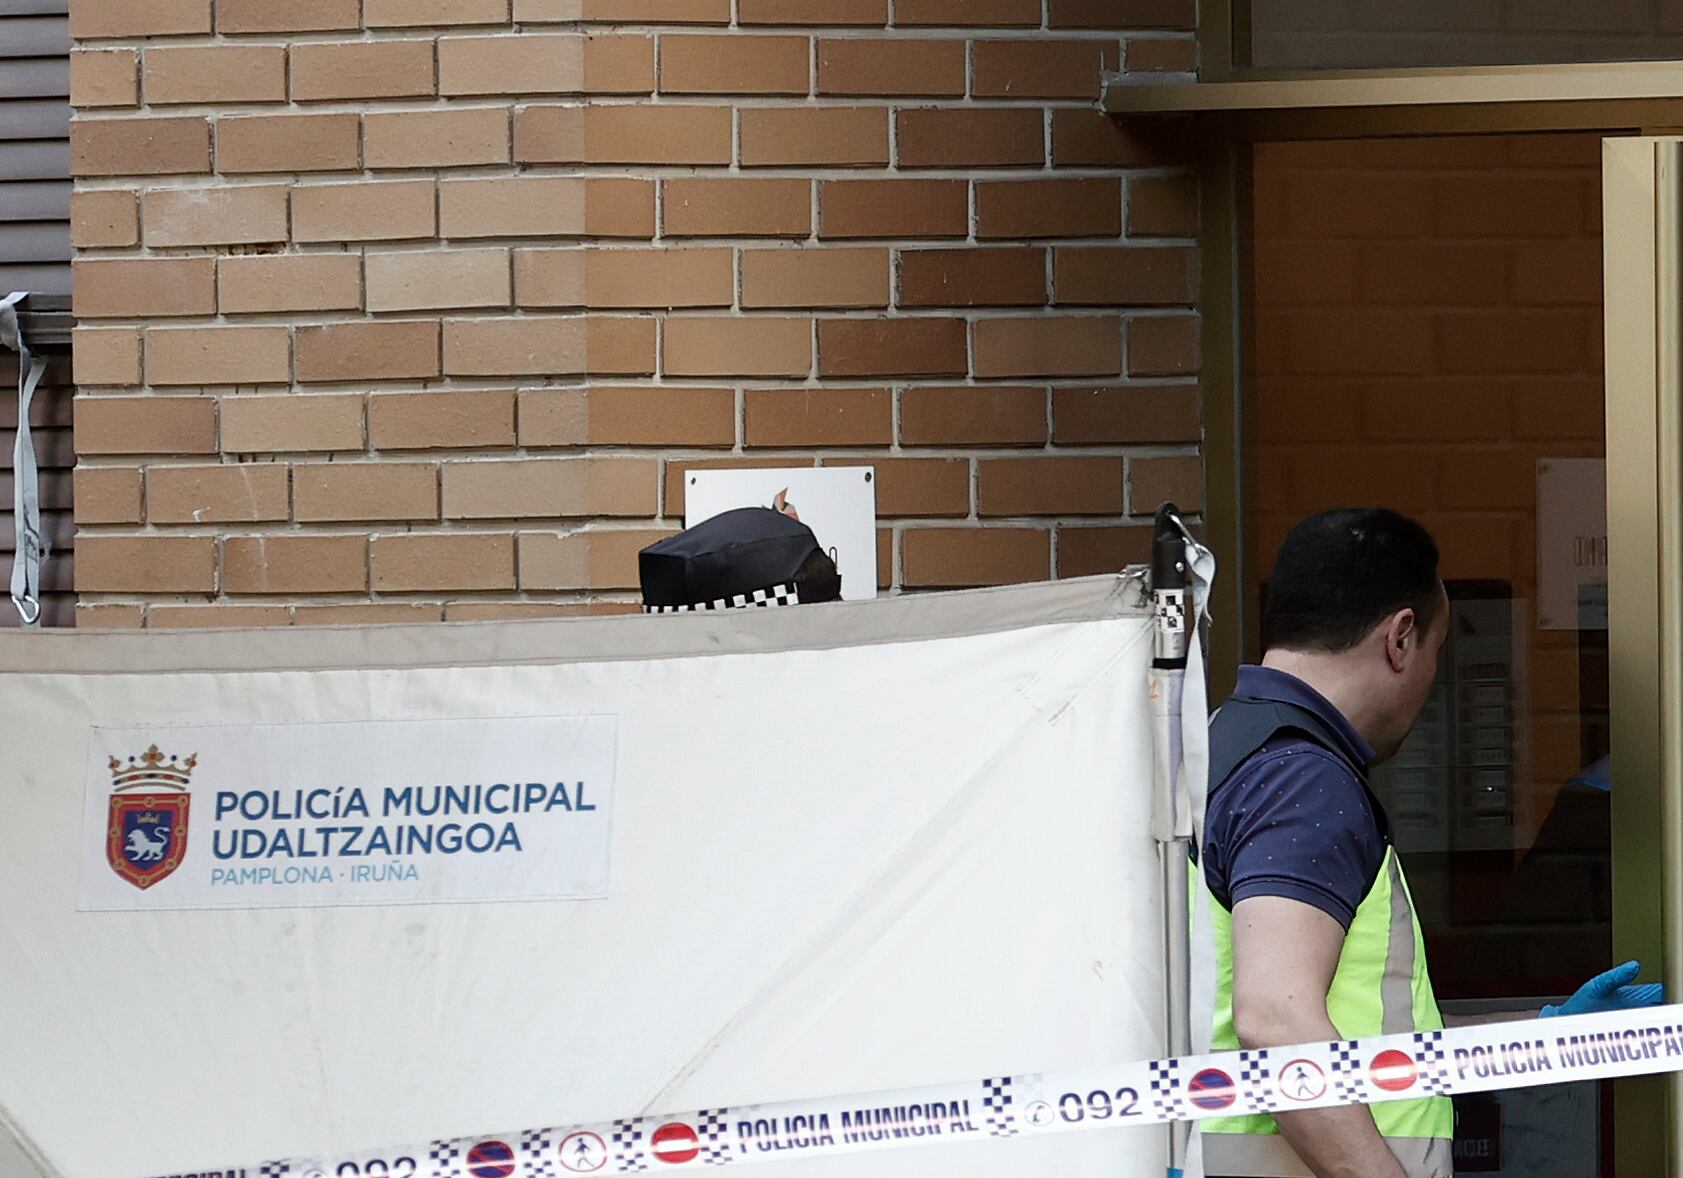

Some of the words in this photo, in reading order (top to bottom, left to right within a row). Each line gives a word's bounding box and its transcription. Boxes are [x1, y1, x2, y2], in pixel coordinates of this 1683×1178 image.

[382, 782, 596, 817] MUNICIPAL
[212, 822, 522, 860] UDALTZAINGOA
[211, 866, 333, 886] PAMPLONA
[350, 860, 420, 883] IRUÑA
[1454, 1040, 1552, 1080] POLICIA
[738, 1113, 835, 1154] POLICIA
[840, 1099, 980, 1145] MUNICIPAL
[1058, 1087, 1143, 1123] 092
